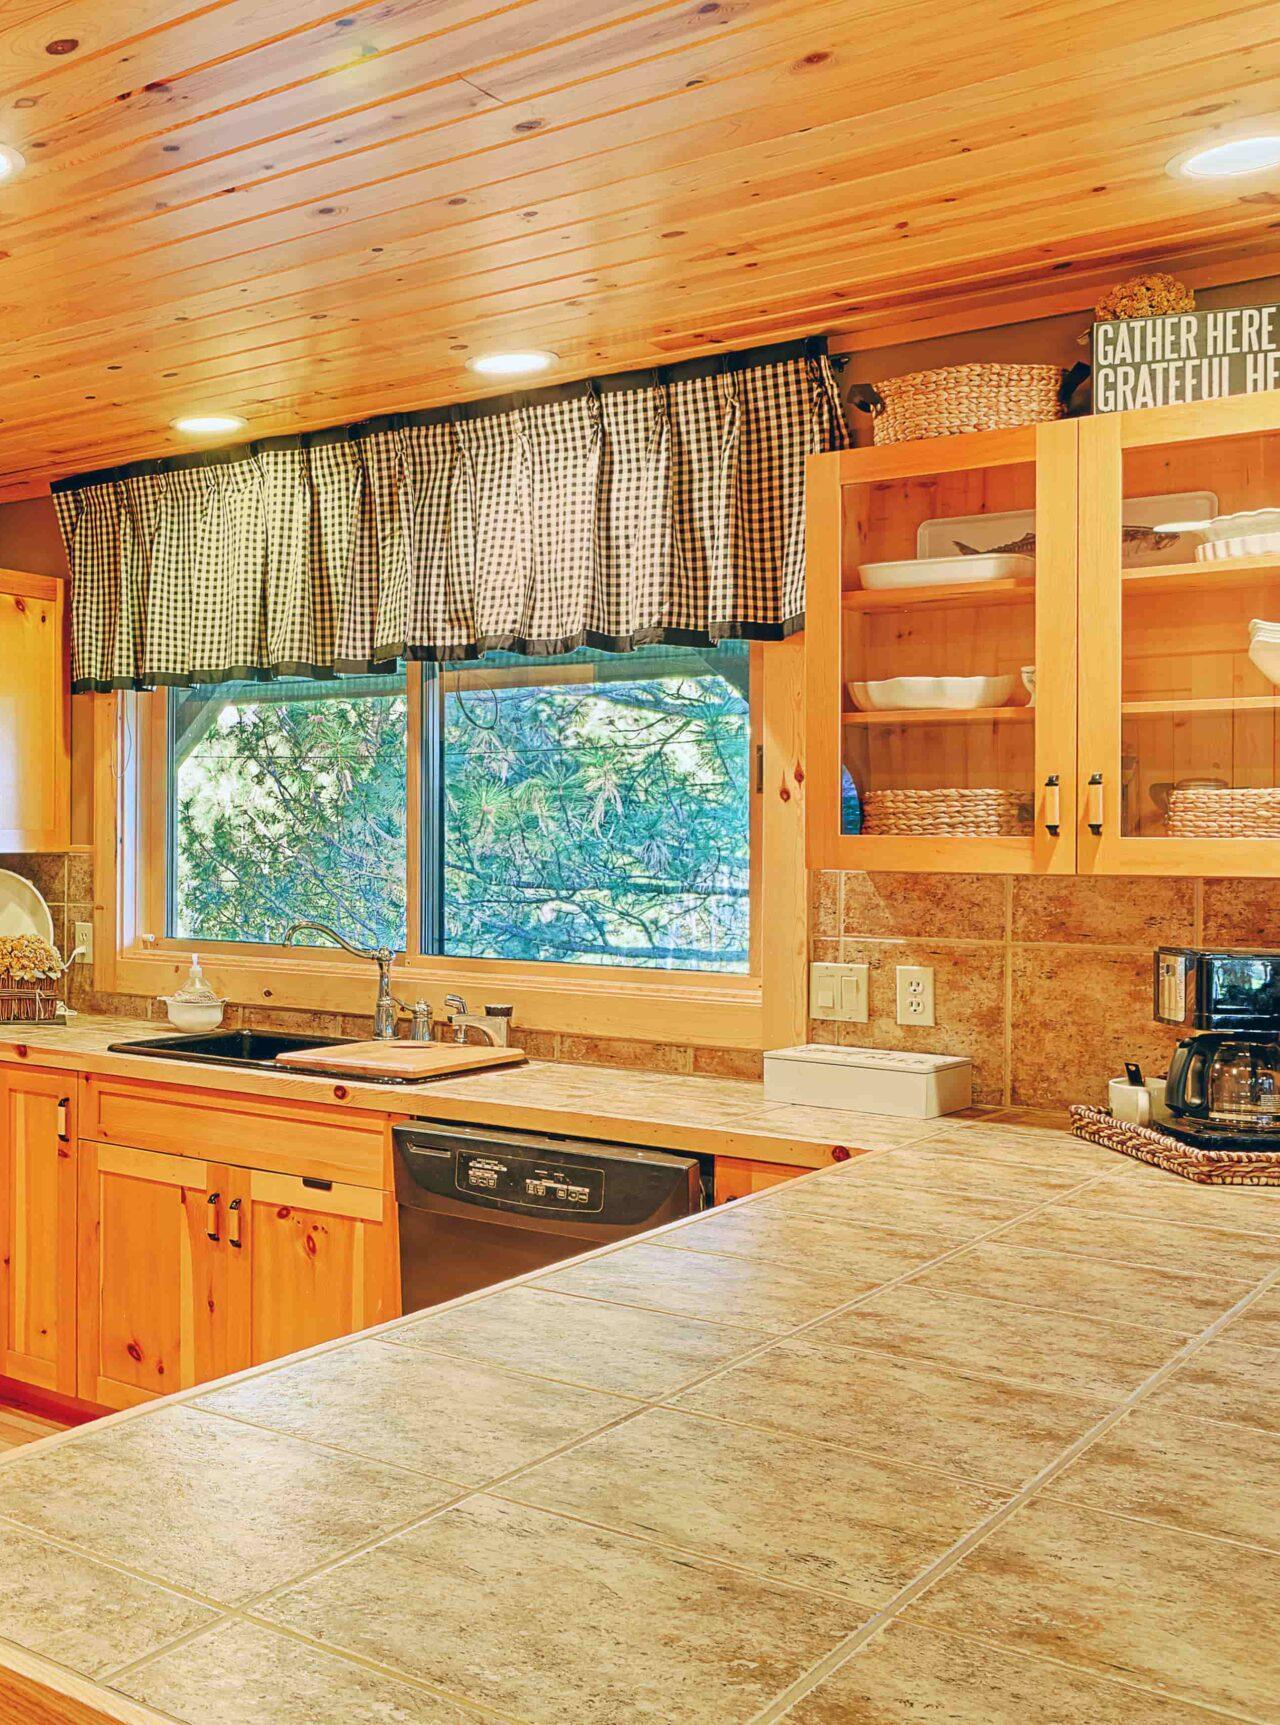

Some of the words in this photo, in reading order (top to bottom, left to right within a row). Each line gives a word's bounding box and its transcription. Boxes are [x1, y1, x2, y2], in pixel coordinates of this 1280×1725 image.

[1097, 315, 1199, 366] GATHER
[1206, 306, 1277, 356] HERE
[1097, 356, 1230, 412] GRATEFUL
